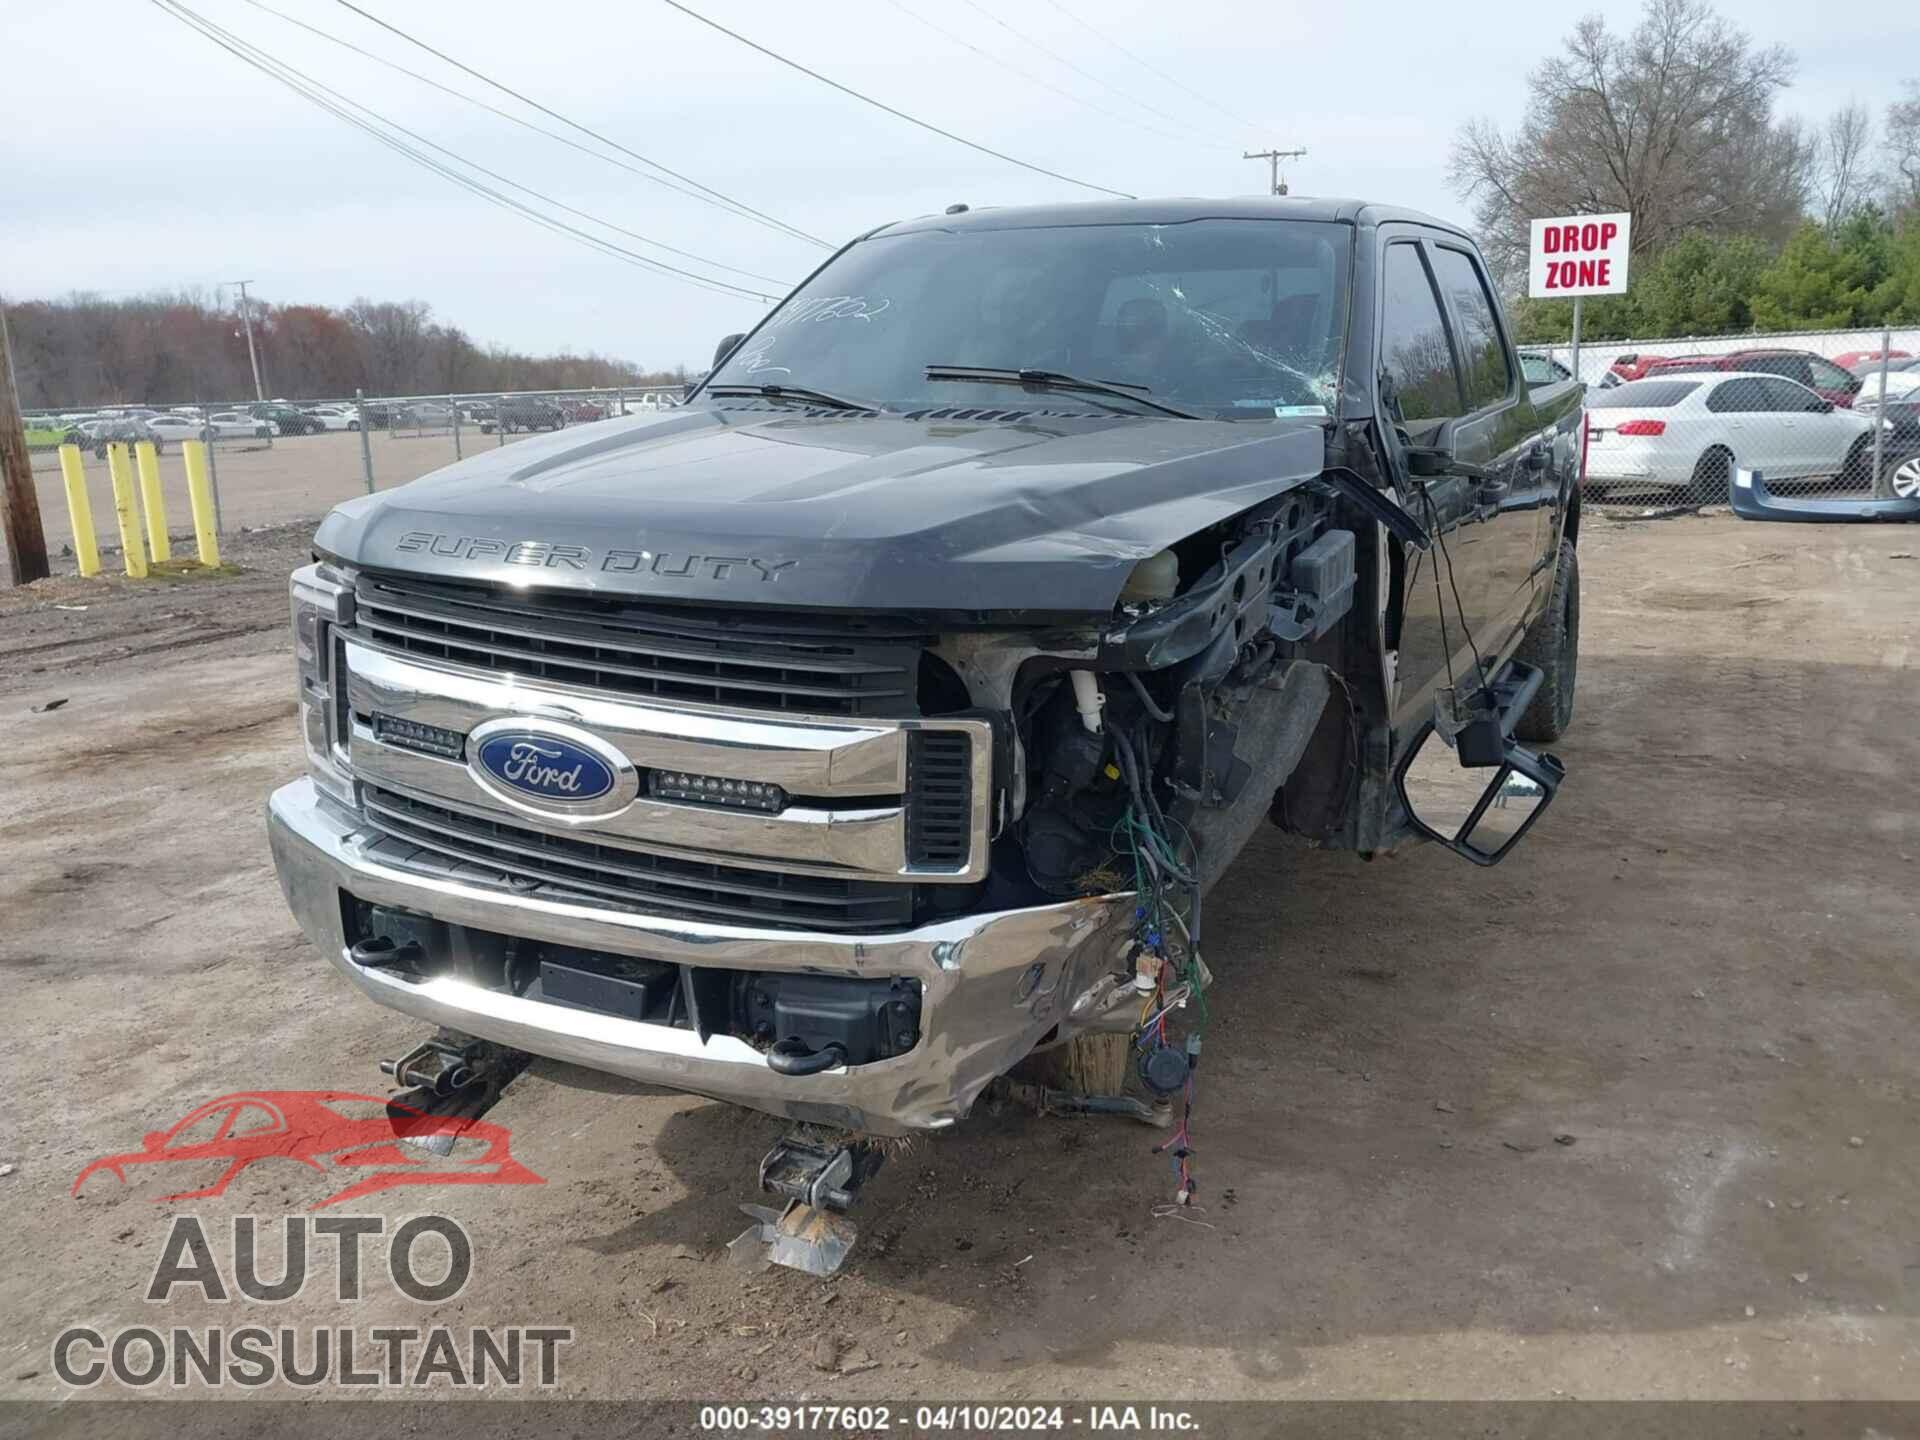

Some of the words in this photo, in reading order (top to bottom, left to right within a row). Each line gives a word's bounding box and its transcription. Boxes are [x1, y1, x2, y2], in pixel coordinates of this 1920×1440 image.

[1544, 223, 1616, 253] DROP
[1546, 259, 1609, 289] ZONE
[396, 531, 592, 571] SUPER
[601, 549, 800, 583] DUTY
[503, 742, 582, 793] Ford
